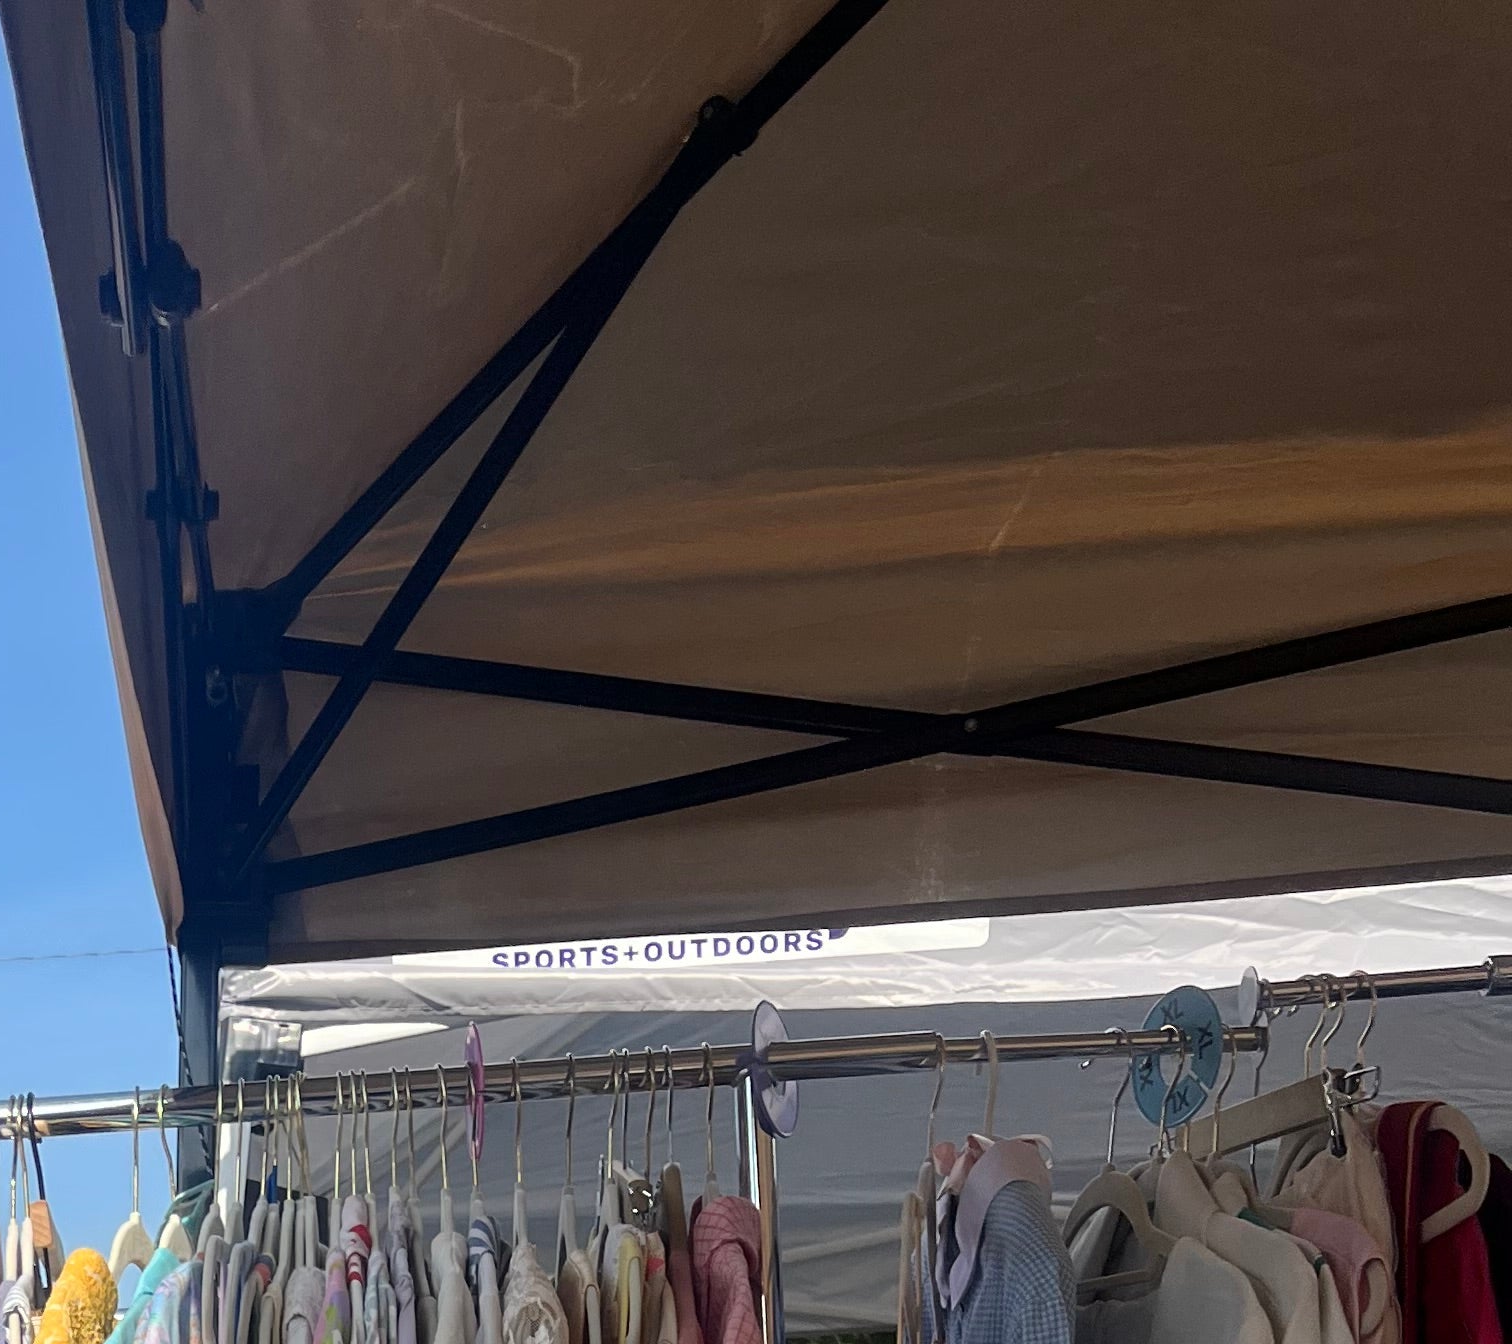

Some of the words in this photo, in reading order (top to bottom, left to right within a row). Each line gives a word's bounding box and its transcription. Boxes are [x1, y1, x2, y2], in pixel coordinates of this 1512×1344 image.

[492, 930, 824, 968] SPORTS+OUTDOORS
[1159, 997, 1185, 1026] XL
[1196, 1019, 1214, 1061] XL
